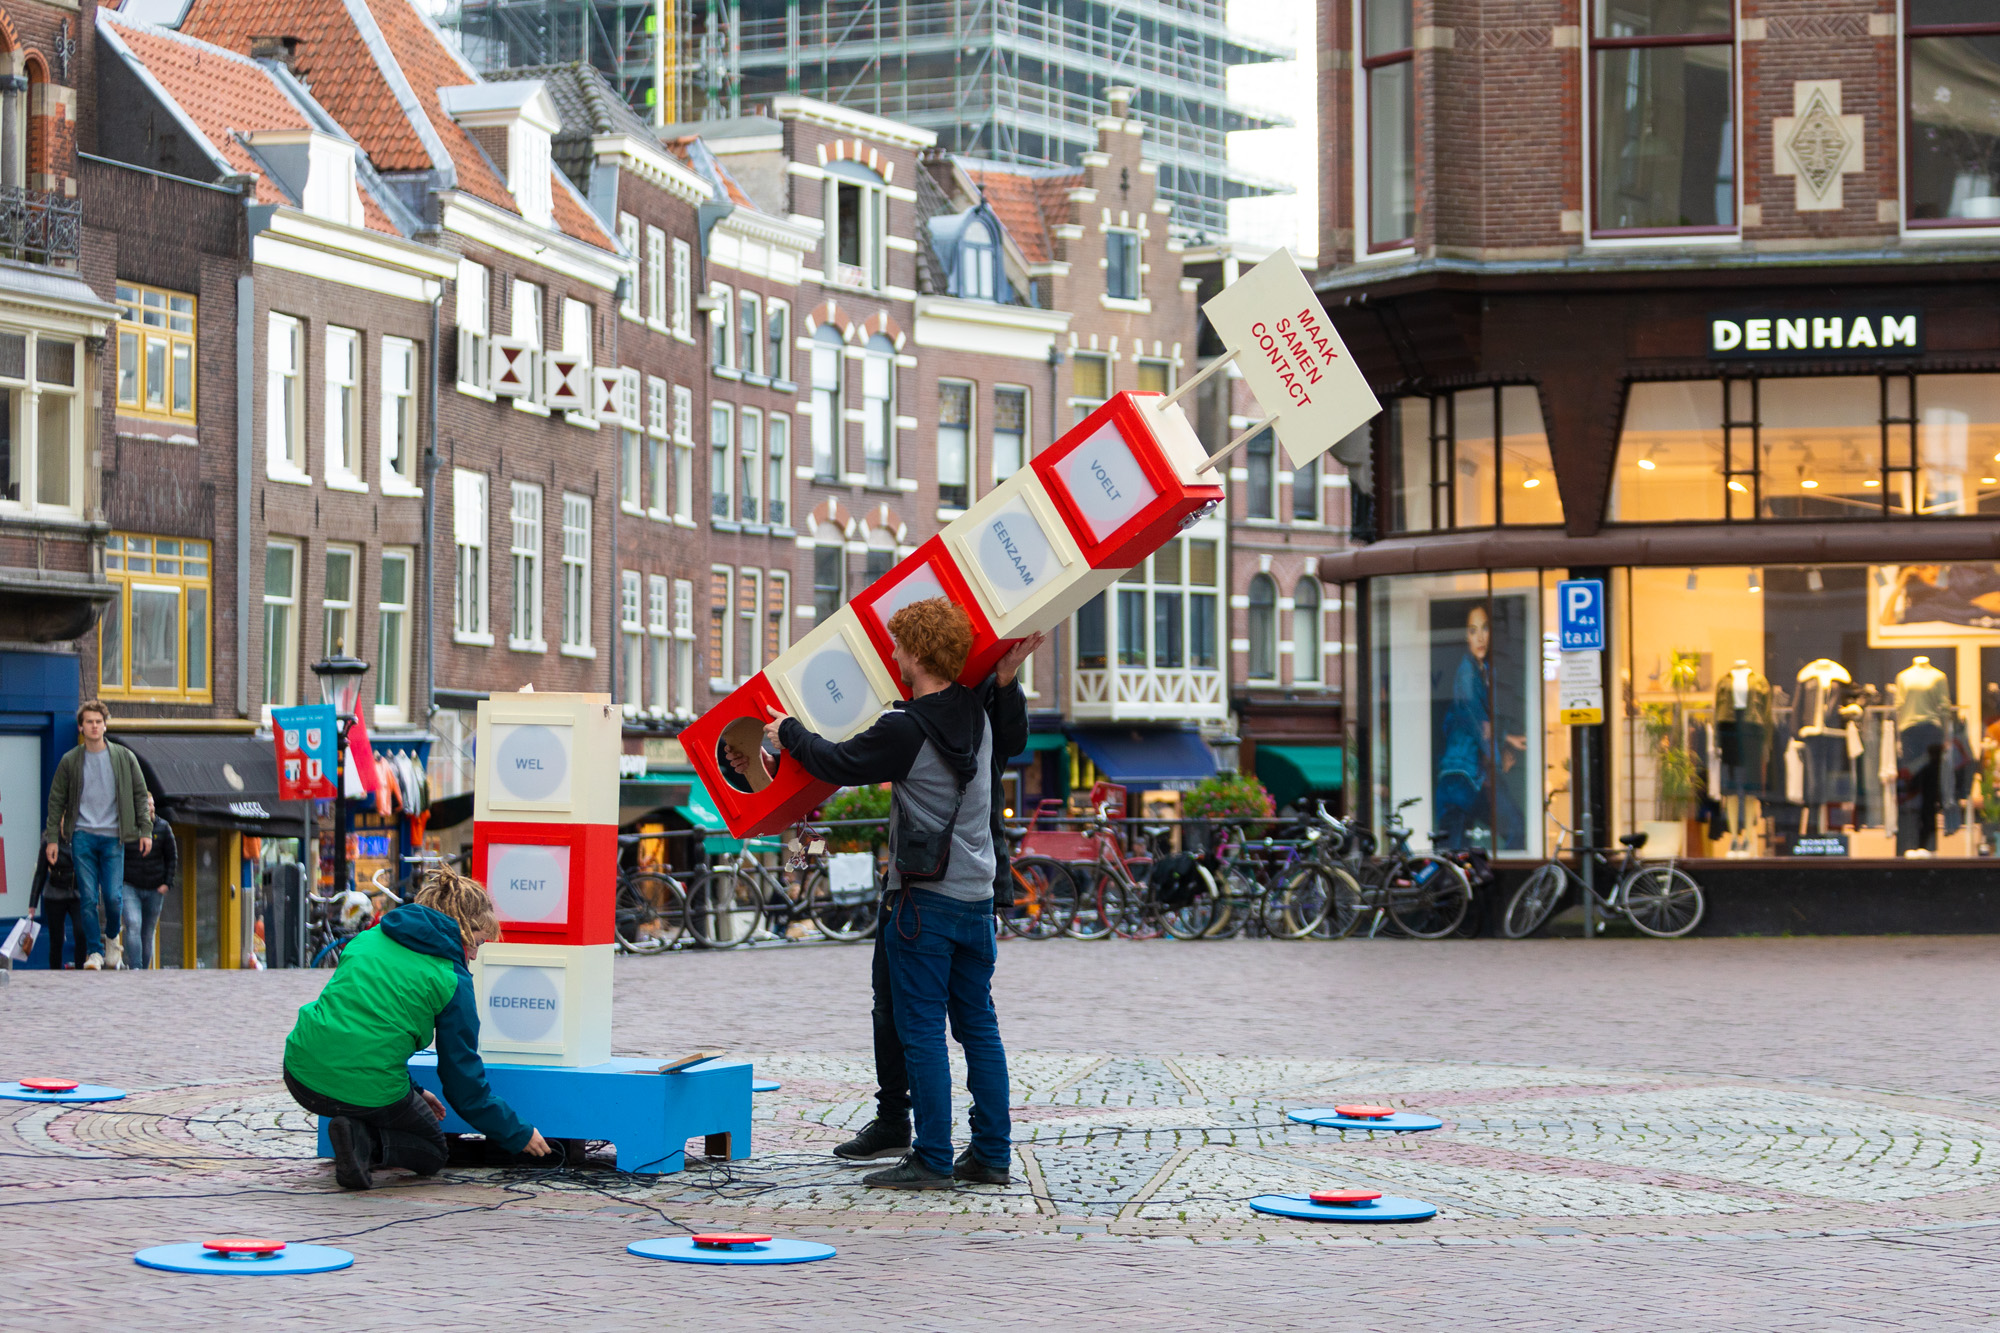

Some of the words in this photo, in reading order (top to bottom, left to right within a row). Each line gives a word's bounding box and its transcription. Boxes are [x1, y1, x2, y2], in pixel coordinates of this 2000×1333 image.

[1297, 308, 1338, 366] MAAK
[1712, 315, 1917, 351] DENHAM
[1252, 322, 1312, 407] CONTACT
[1276, 318, 1323, 385] SAMEN
[1091, 459, 1121, 500] VOELT
[993, 520, 1034, 586] EENZAAM
[1568, 586, 1593, 622] P
[1564, 629, 1600, 644] taxi
[825, 679, 844, 704] DIE
[515, 757, 544, 771] WEL
[510, 878, 547, 891] KENT
[489, 996, 556, 1010] IEDEREEN
